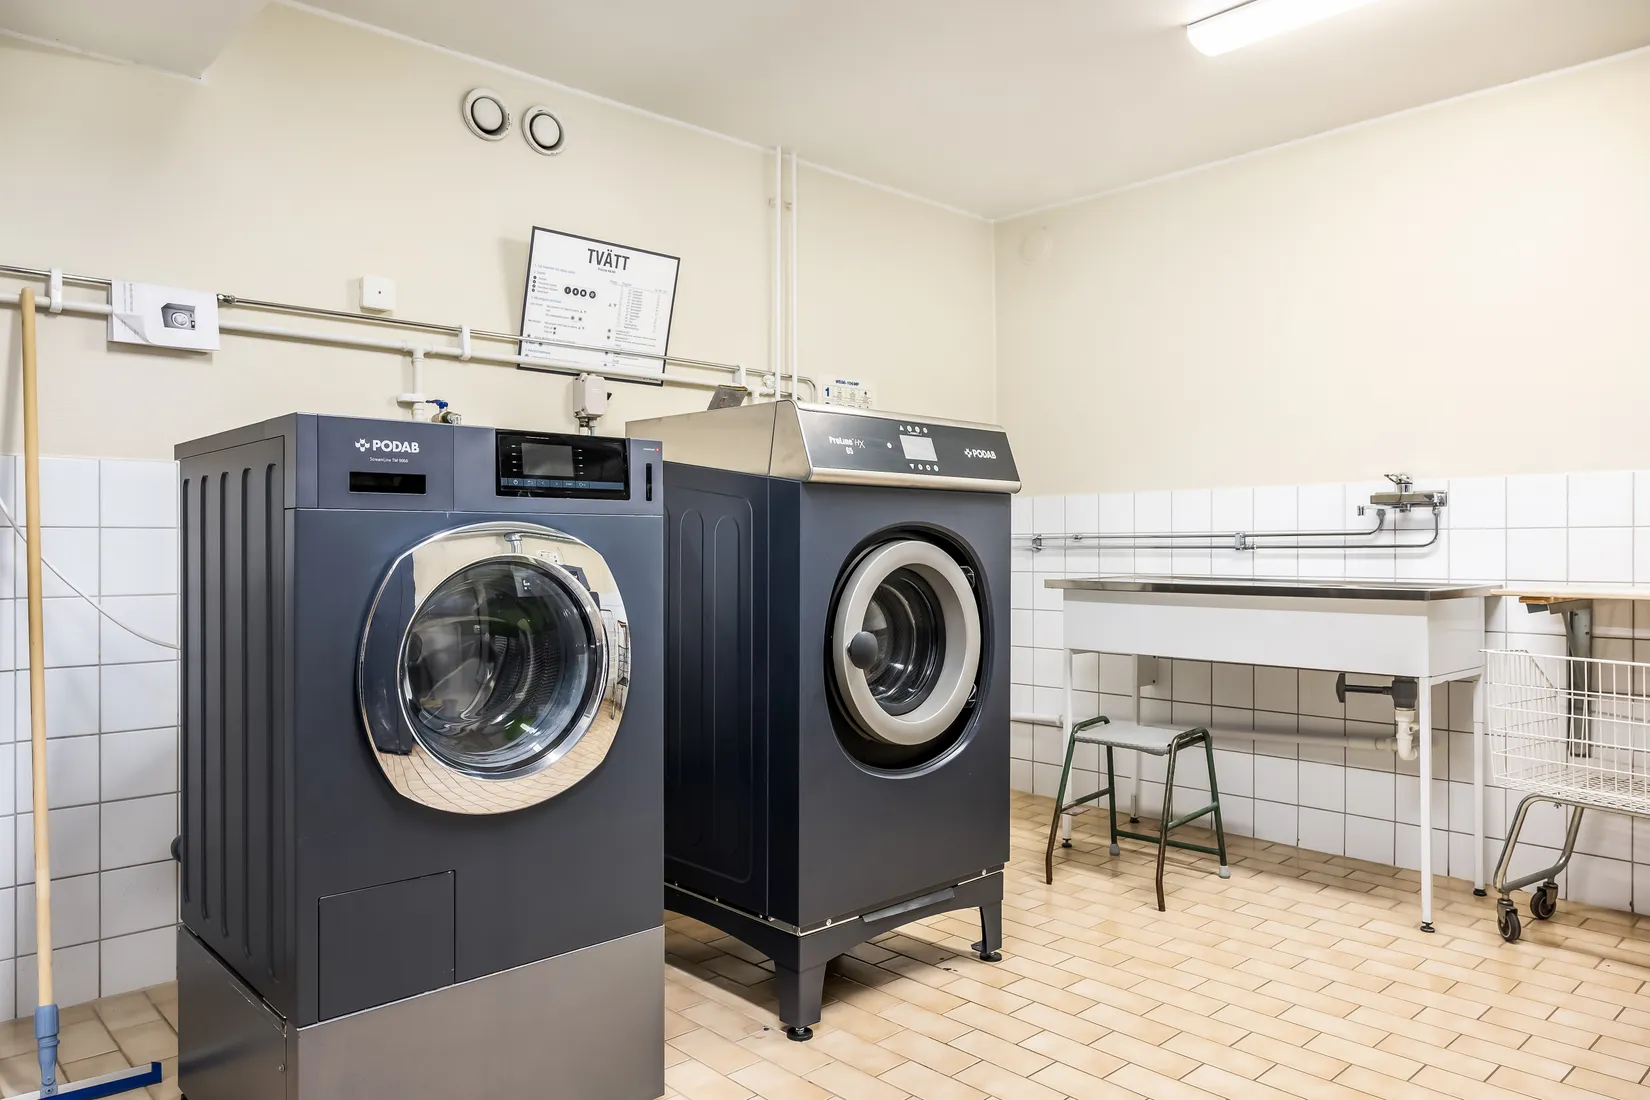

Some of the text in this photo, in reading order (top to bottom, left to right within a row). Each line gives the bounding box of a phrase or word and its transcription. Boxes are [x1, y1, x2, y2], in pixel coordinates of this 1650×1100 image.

[587, 248, 630, 271] TVÄTT
[825, 386, 830, 397] 1
[372, 439, 420, 454] PODAB
[971, 448, 997, 460] PODAB
